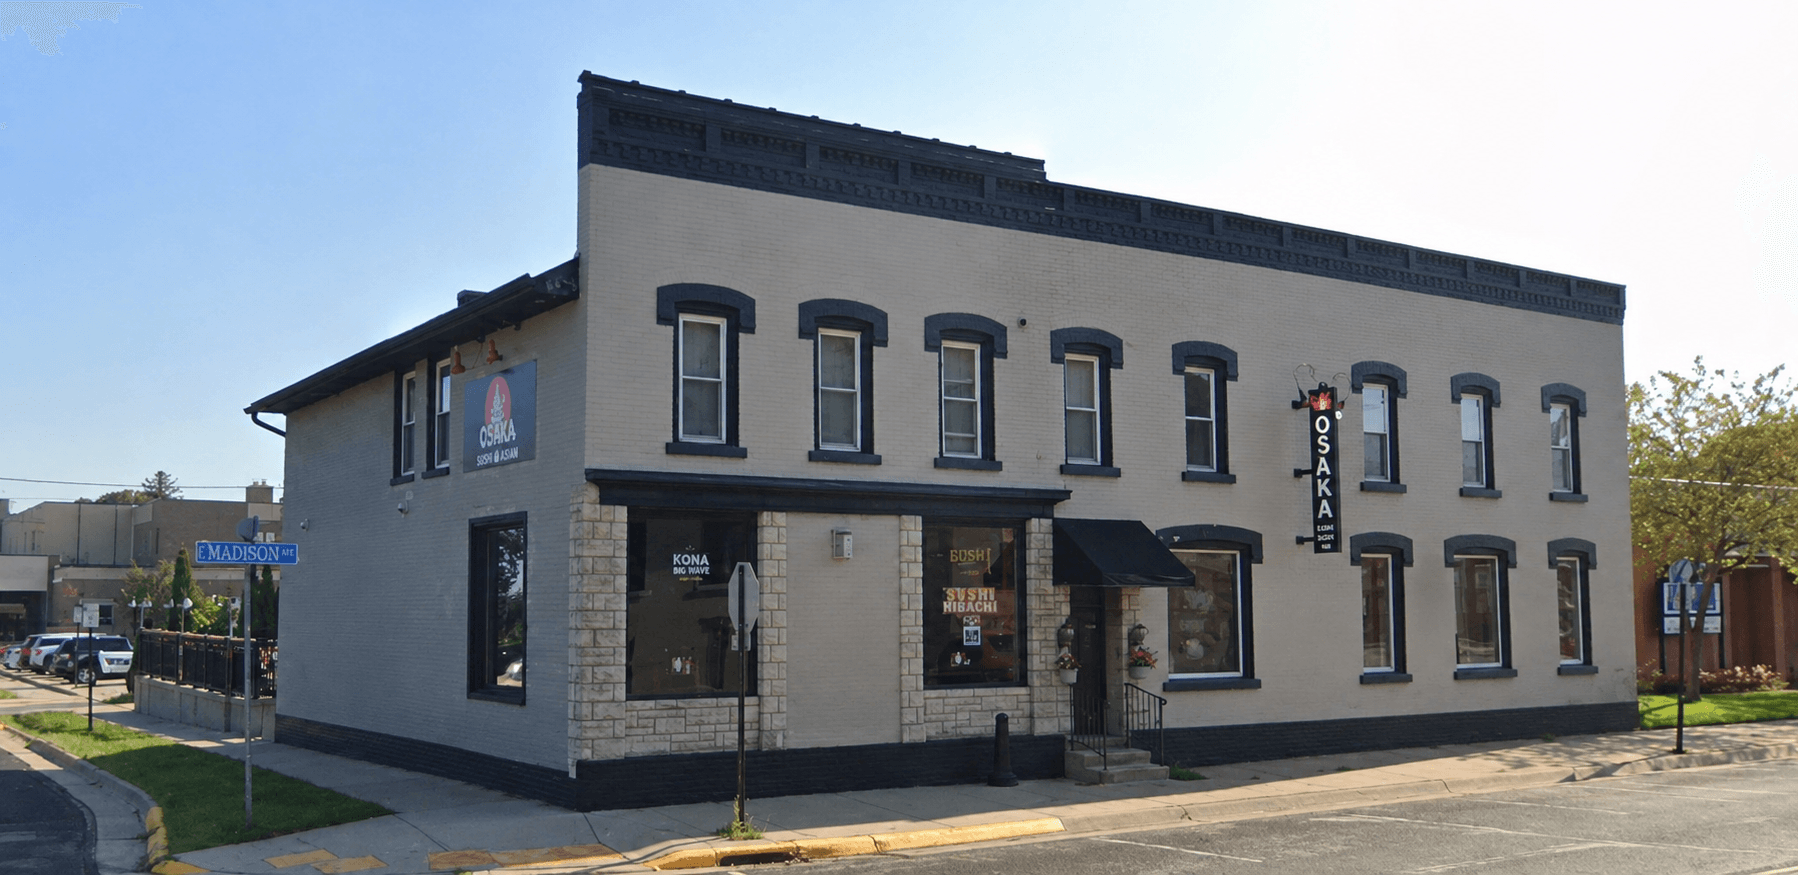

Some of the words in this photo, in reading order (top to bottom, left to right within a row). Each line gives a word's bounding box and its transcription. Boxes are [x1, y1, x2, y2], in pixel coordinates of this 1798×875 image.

[480, 418, 516, 449] OSAKA
[1315, 415, 1333, 519] OSAKA
[198, 545, 206, 560] E
[207, 543, 280, 562] MADISON
[673, 553, 710, 566] KONA
[673, 566, 687, 575] BIG
[688, 566, 710, 575] WAVE
[945, 587, 996, 601] SUSHI
[942, 600, 998, 613] HIBACHI
